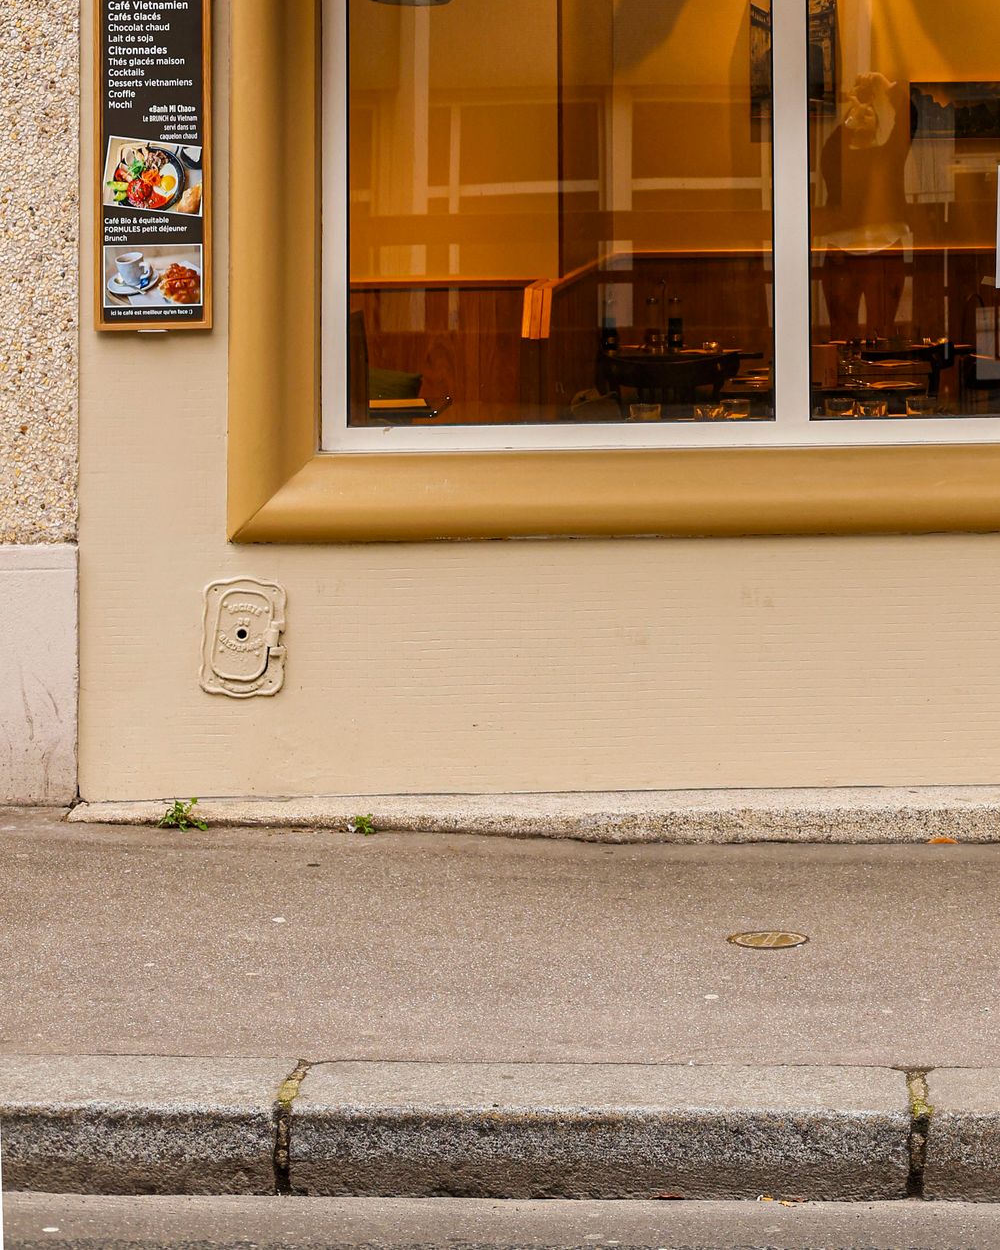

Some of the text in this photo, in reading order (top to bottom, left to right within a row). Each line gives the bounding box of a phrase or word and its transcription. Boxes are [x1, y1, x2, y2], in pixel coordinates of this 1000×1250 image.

[107, 0, 189, 10] Café Vietnamien
[108, 12, 162, 21] Cafés Glacés
[108, 23, 170, 31] Chocolat chaud
[108, 34, 154, 43] Lait de soja
[108, 46, 168, 55] Citronnades
[108, 57, 185, 67] Thés glacés maison
[108, 68, 145, 77] Cocktails
[108, 78, 193, 87] Desserts vietnamiens
[108, 90, 136, 98] Croffle
[108, 100, 133, 109] Mochi
[139, 216, 170, 224] équitable
[142, 225, 158, 233] petit
[159, 225, 187, 233] déjeuner
